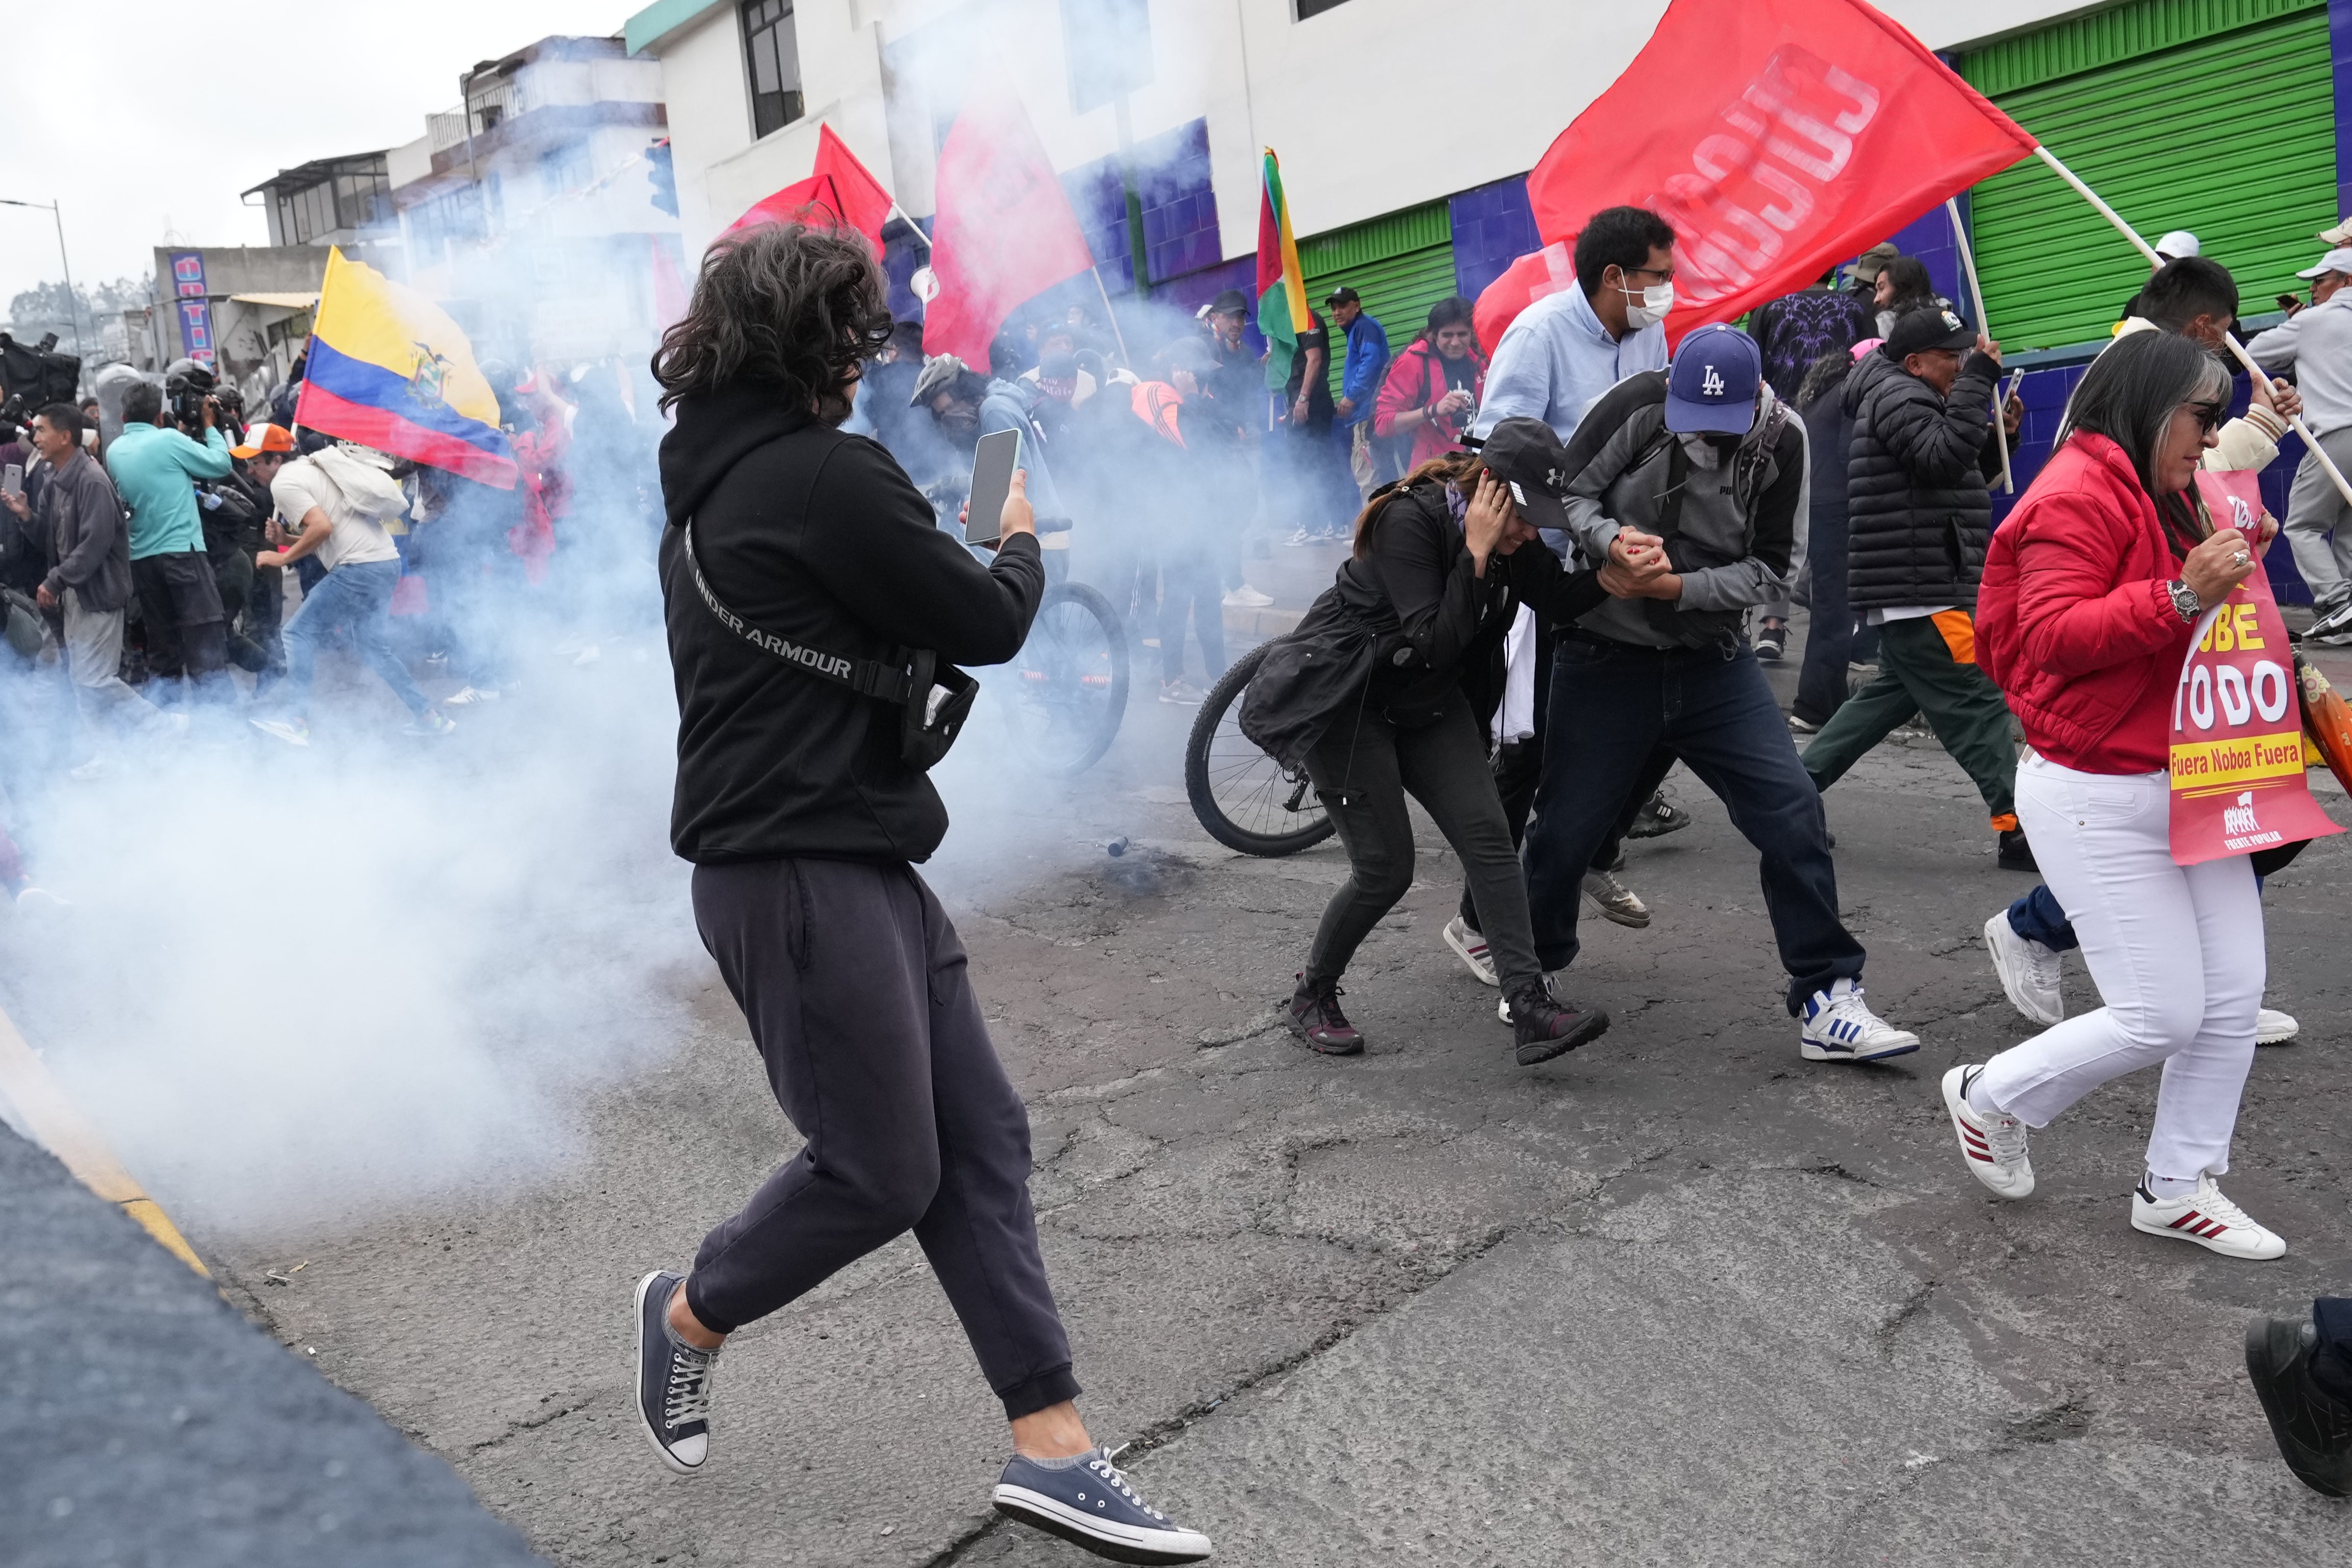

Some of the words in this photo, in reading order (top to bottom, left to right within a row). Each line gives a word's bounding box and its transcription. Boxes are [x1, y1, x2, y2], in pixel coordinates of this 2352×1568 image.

[1702, 365, 1724, 395] LA
[1719, 485, 1733, 495] PU
[696, 568, 743, 634] UNDER
[746, 629, 851, 679] ARMOUR
[2172, 752, 2208, 777] Fuera
[2211, 747, 2252, 772] Noboa
[2255, 743, 2299, 767] Fuera
[2248, 831, 2283, 845] POPULAR
